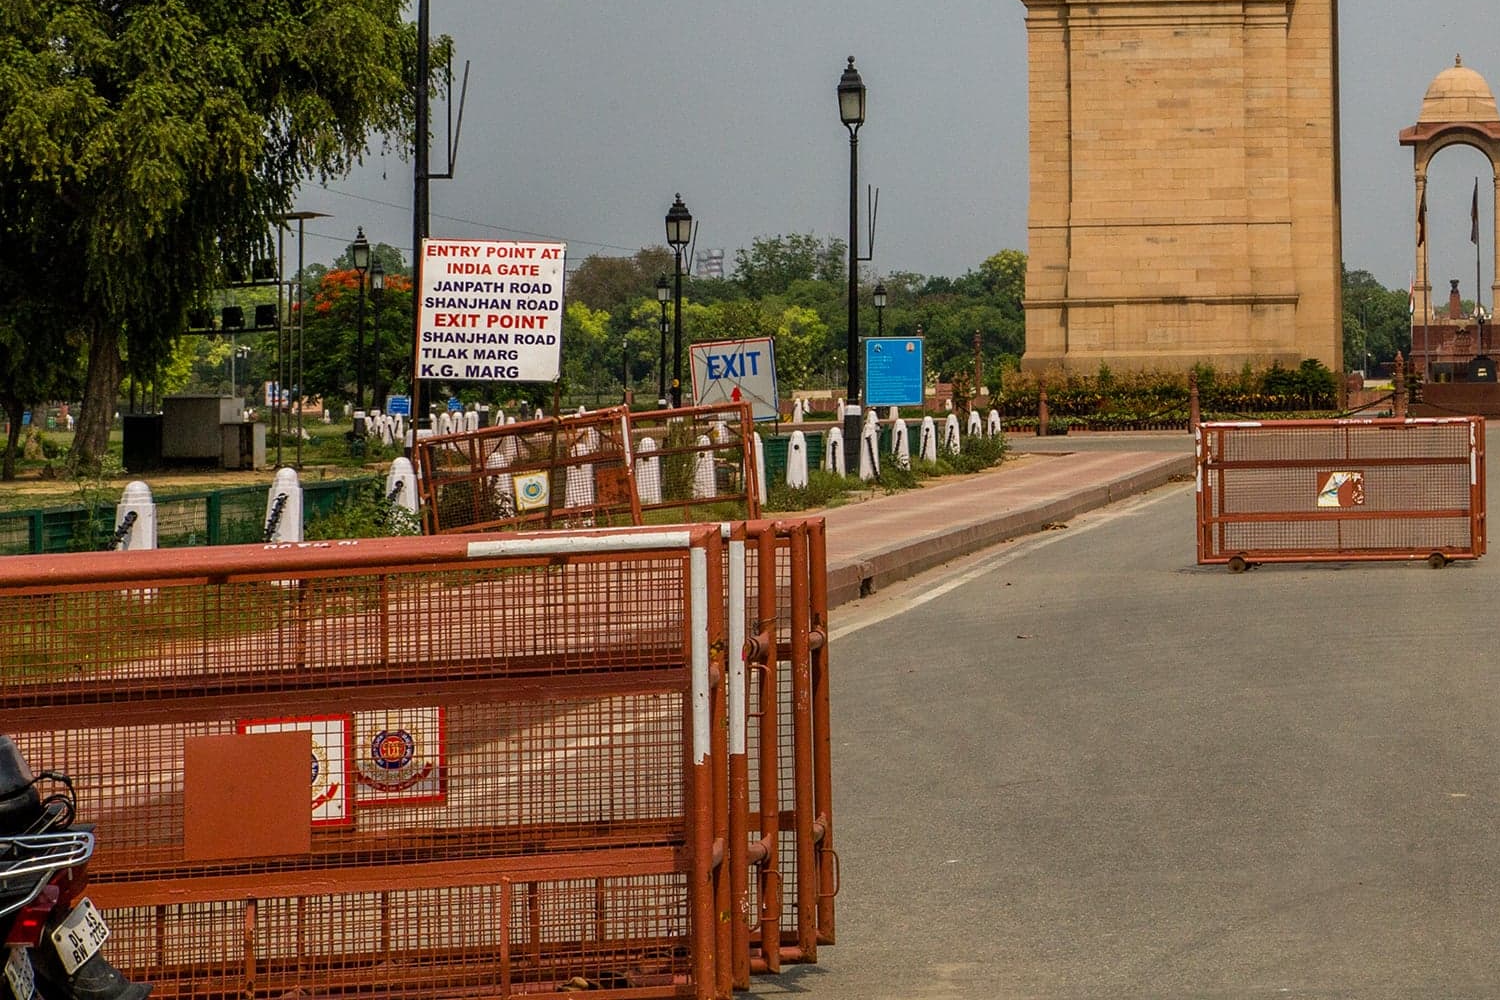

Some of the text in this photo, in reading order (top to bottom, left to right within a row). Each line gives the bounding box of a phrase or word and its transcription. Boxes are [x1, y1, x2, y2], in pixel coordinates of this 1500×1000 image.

[426, 245, 561, 259] ENTRY POINT AT
[447, 263, 540, 276] INDIA GATE
[433, 281, 552, 294] JANPATH ROAD
[425, 297, 558, 310] SHANJHAN ROAD
[435, 314, 548, 329] EXIT POINT
[423, 332, 556, 345] SHANJHAN ROAD
[422, 348, 518, 360] TILAK MARG
[422, 364, 519, 378] K.G. MARG
[707, 351, 760, 379] EXIT
[69, 930, 84, 948] DL
[73, 944, 89, 965] BW
